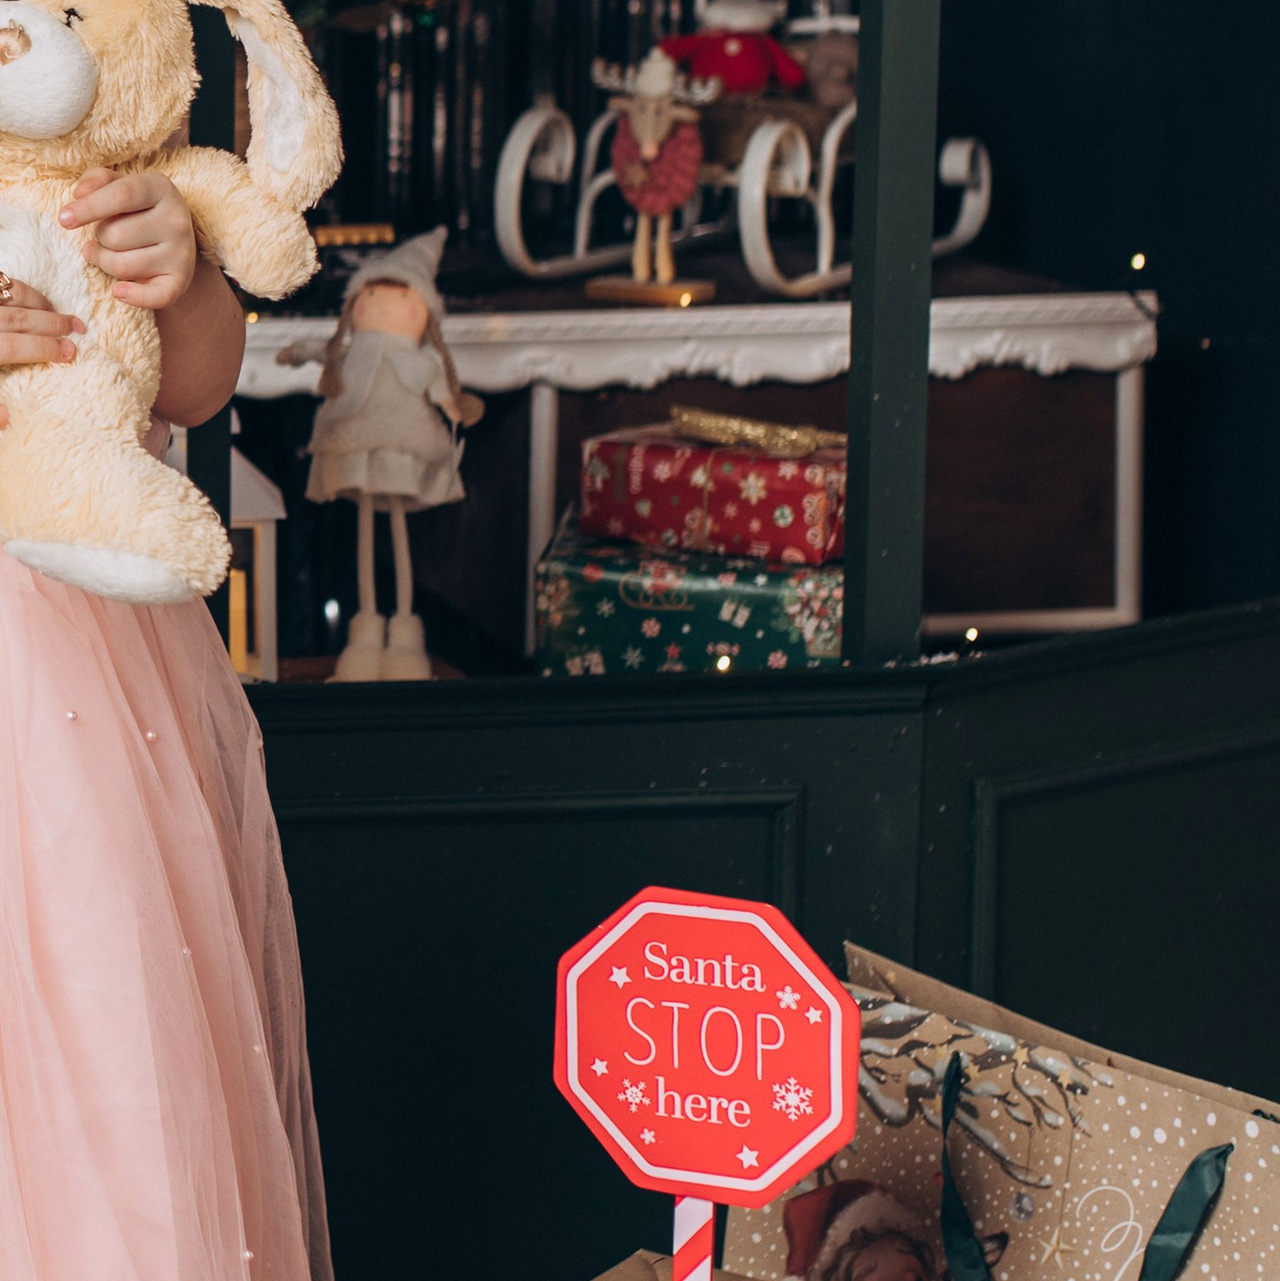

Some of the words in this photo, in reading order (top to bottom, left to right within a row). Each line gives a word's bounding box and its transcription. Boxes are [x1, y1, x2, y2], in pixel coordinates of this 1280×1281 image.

[643, 941, 767, 993] Santa
[624, 997, 786, 1081] STOP
[655, 1075, 752, 1128] here
